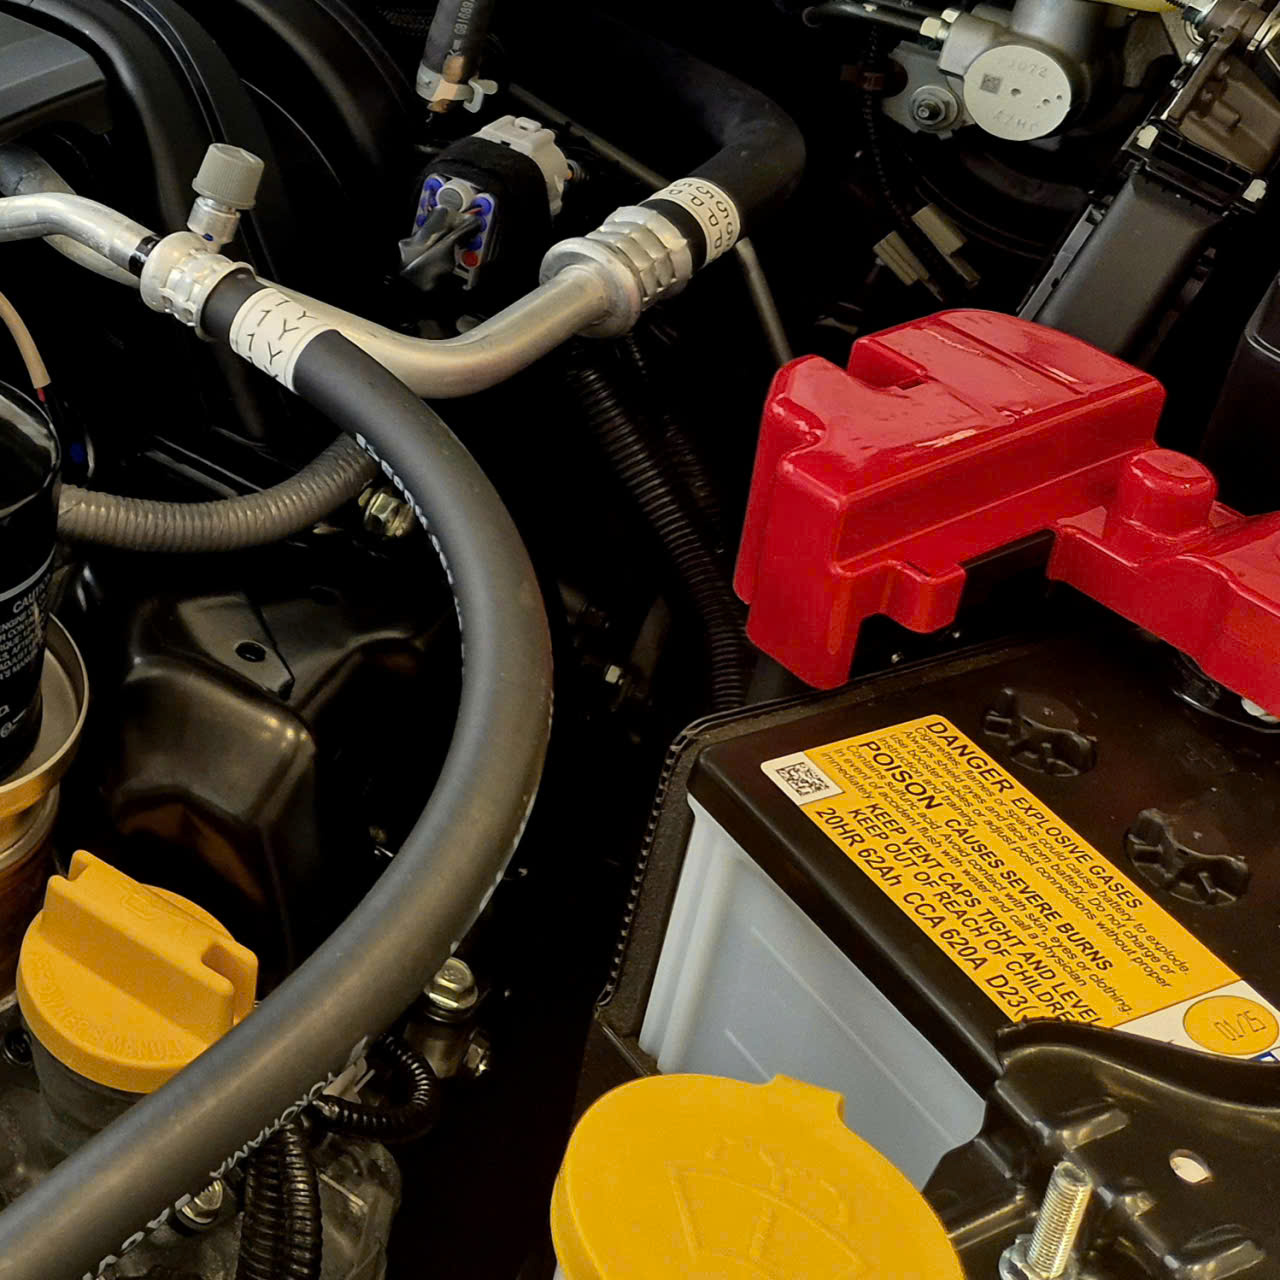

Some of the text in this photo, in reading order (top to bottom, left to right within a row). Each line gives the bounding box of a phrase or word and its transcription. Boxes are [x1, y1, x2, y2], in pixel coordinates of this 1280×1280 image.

[814, 806, 867, 847] 20HR
[855, 846, 908, 887] 62Ah
[900, 890, 950, 928] CCA
[937, 927, 992, 970] 620A
[842, 758, 871, 780] event
[866, 780, 883, 790] of
[877, 790, 921, 826] accident
[915, 826, 945, 848] flush
[938, 848, 965, 868] with
[959, 868, 993, 894] water
[987, 894, 1013, 913] and
[1007, 913, 1033, 931] call
[1033, 940, 1090, 987] physician
[844, 744, 888, 780] Contains
[938, 832, 972, 858] Avoid
[966, 858, 1008, 891] contact
[1001, 891, 1029, 911] with
[1022, 912, 1054, 935] skin,
[1045, 935, 1079, 961] eyes
[1074, 960, 1092, 972] or
[1085, 972, 1138, 1015] clothing.
[857, 740, 1115, 971] POISON CAUSES SEVERE BURNS
[875, 736, 981, 829] instruction and training.
[888, 733, 1171, 989] use booster cables or adjust post connections without proper
[899, 730, 1176, 976] Always shield eyes and face from battery. Do not charge or
[924, 721, 1144, 909] DANGER EXPLOSIVE GASES
[961, 769, 998, 797] flames
[992, 797, 1008, 808] or
[1002, 808, 1042, 837] sparks
[1036, 837, 1069, 862] could
[1064, 862, 1099, 890] cause
[1093, 890, 1137, 923] battery
[1131, 923, 1148, 933] to
[1142, 933, 1194, 975] explode.
[847, 808, 1077, 1023] KEEP OUT OF REACH OF CHILDRE
[864, 803, 908, 836] KEEP
[899, 836, 944, 871] VENT
[936, 871, 983, 908] CAPS
[974, 908, 1026, 950] TIGHT
[1016, 949, 1059, 981] AND
